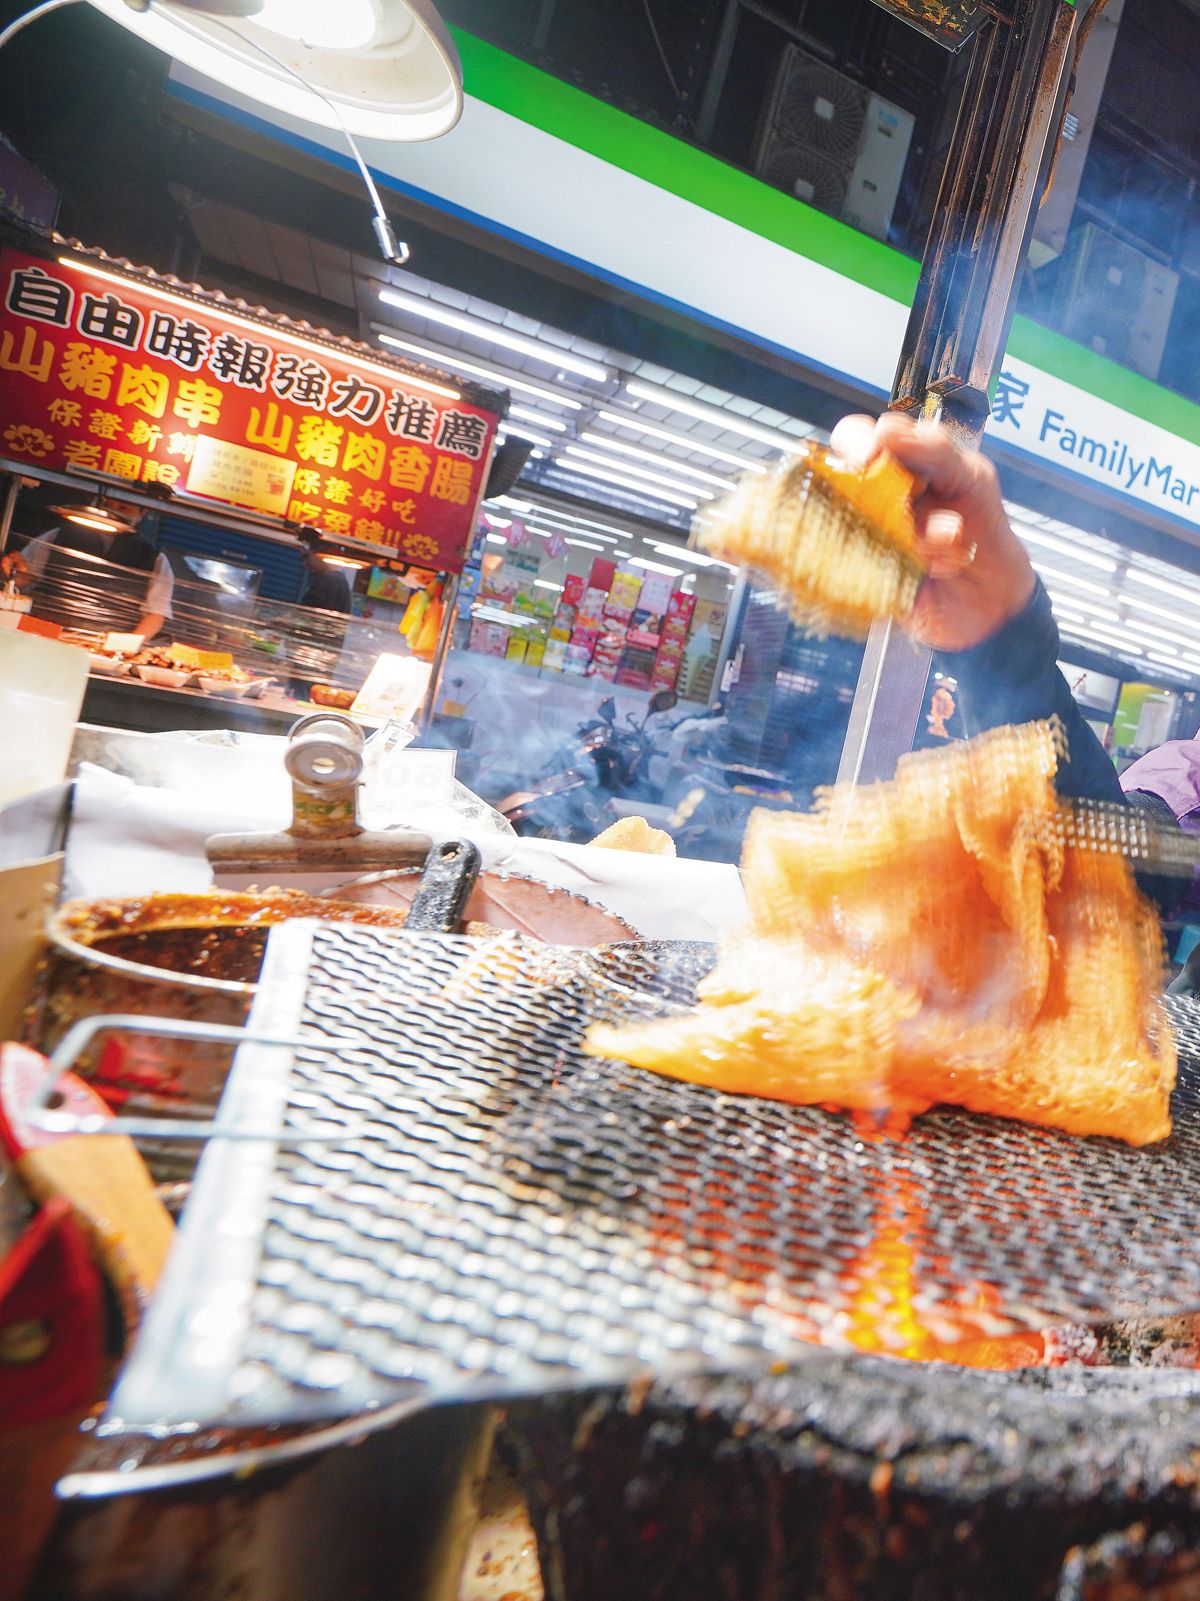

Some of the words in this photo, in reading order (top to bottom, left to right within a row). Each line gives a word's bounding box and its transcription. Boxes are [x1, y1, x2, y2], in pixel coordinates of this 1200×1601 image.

[0, 326, 224, 428] 山豬肉串
[245, 402, 474, 506] 山豬肉香腸
[6, 266, 488, 460] 自由時報強力推薦
[294, 467, 417, 524] 保證好吃
